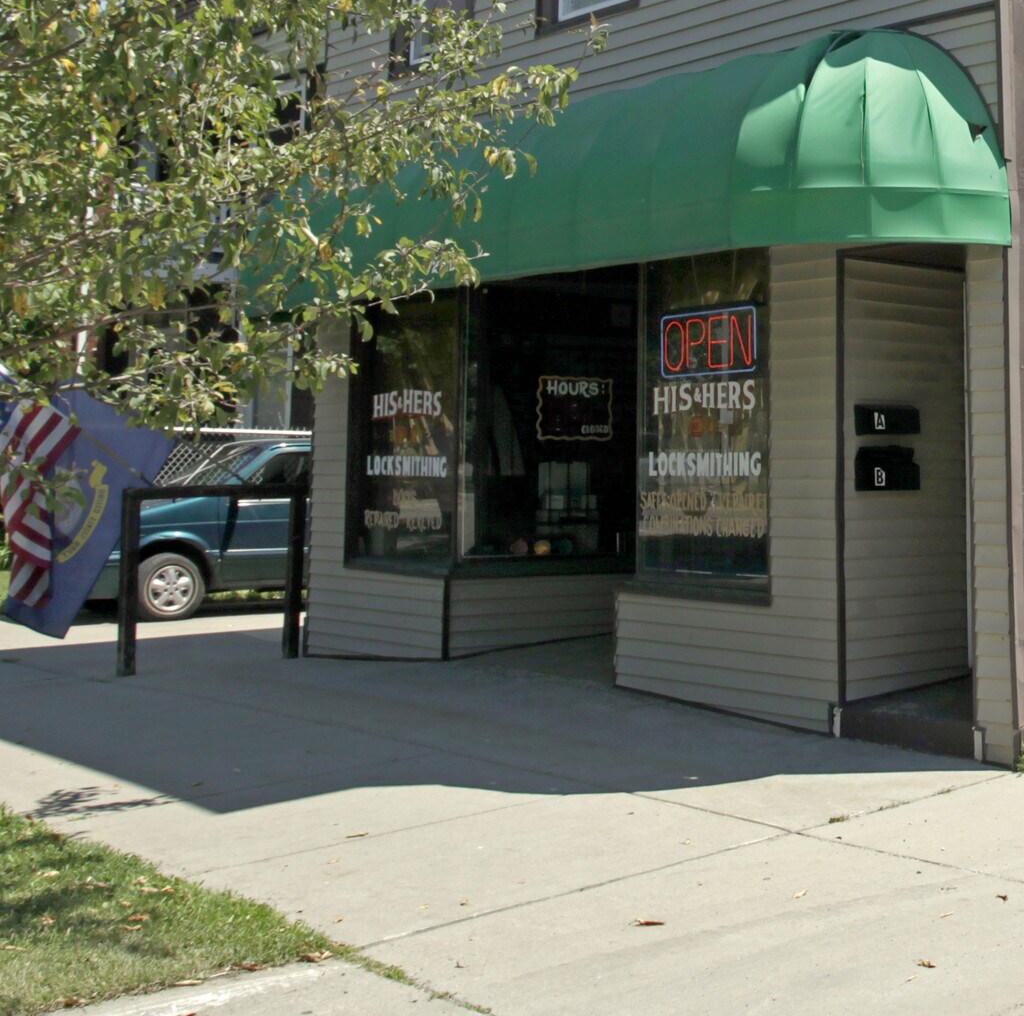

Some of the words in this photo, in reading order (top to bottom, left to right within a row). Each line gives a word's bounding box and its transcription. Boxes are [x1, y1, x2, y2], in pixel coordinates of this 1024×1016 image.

[664, 314, 753, 372] OPEN
[546, 379, 605, 398] HOURS:
[581, 424, 609, 435] CLOSED
[366, 455, 448, 478] LOCKSMITHING
[648, 451, 762, 477] LOCKSMITHING
[715, 517, 765, 539] CHANGED
